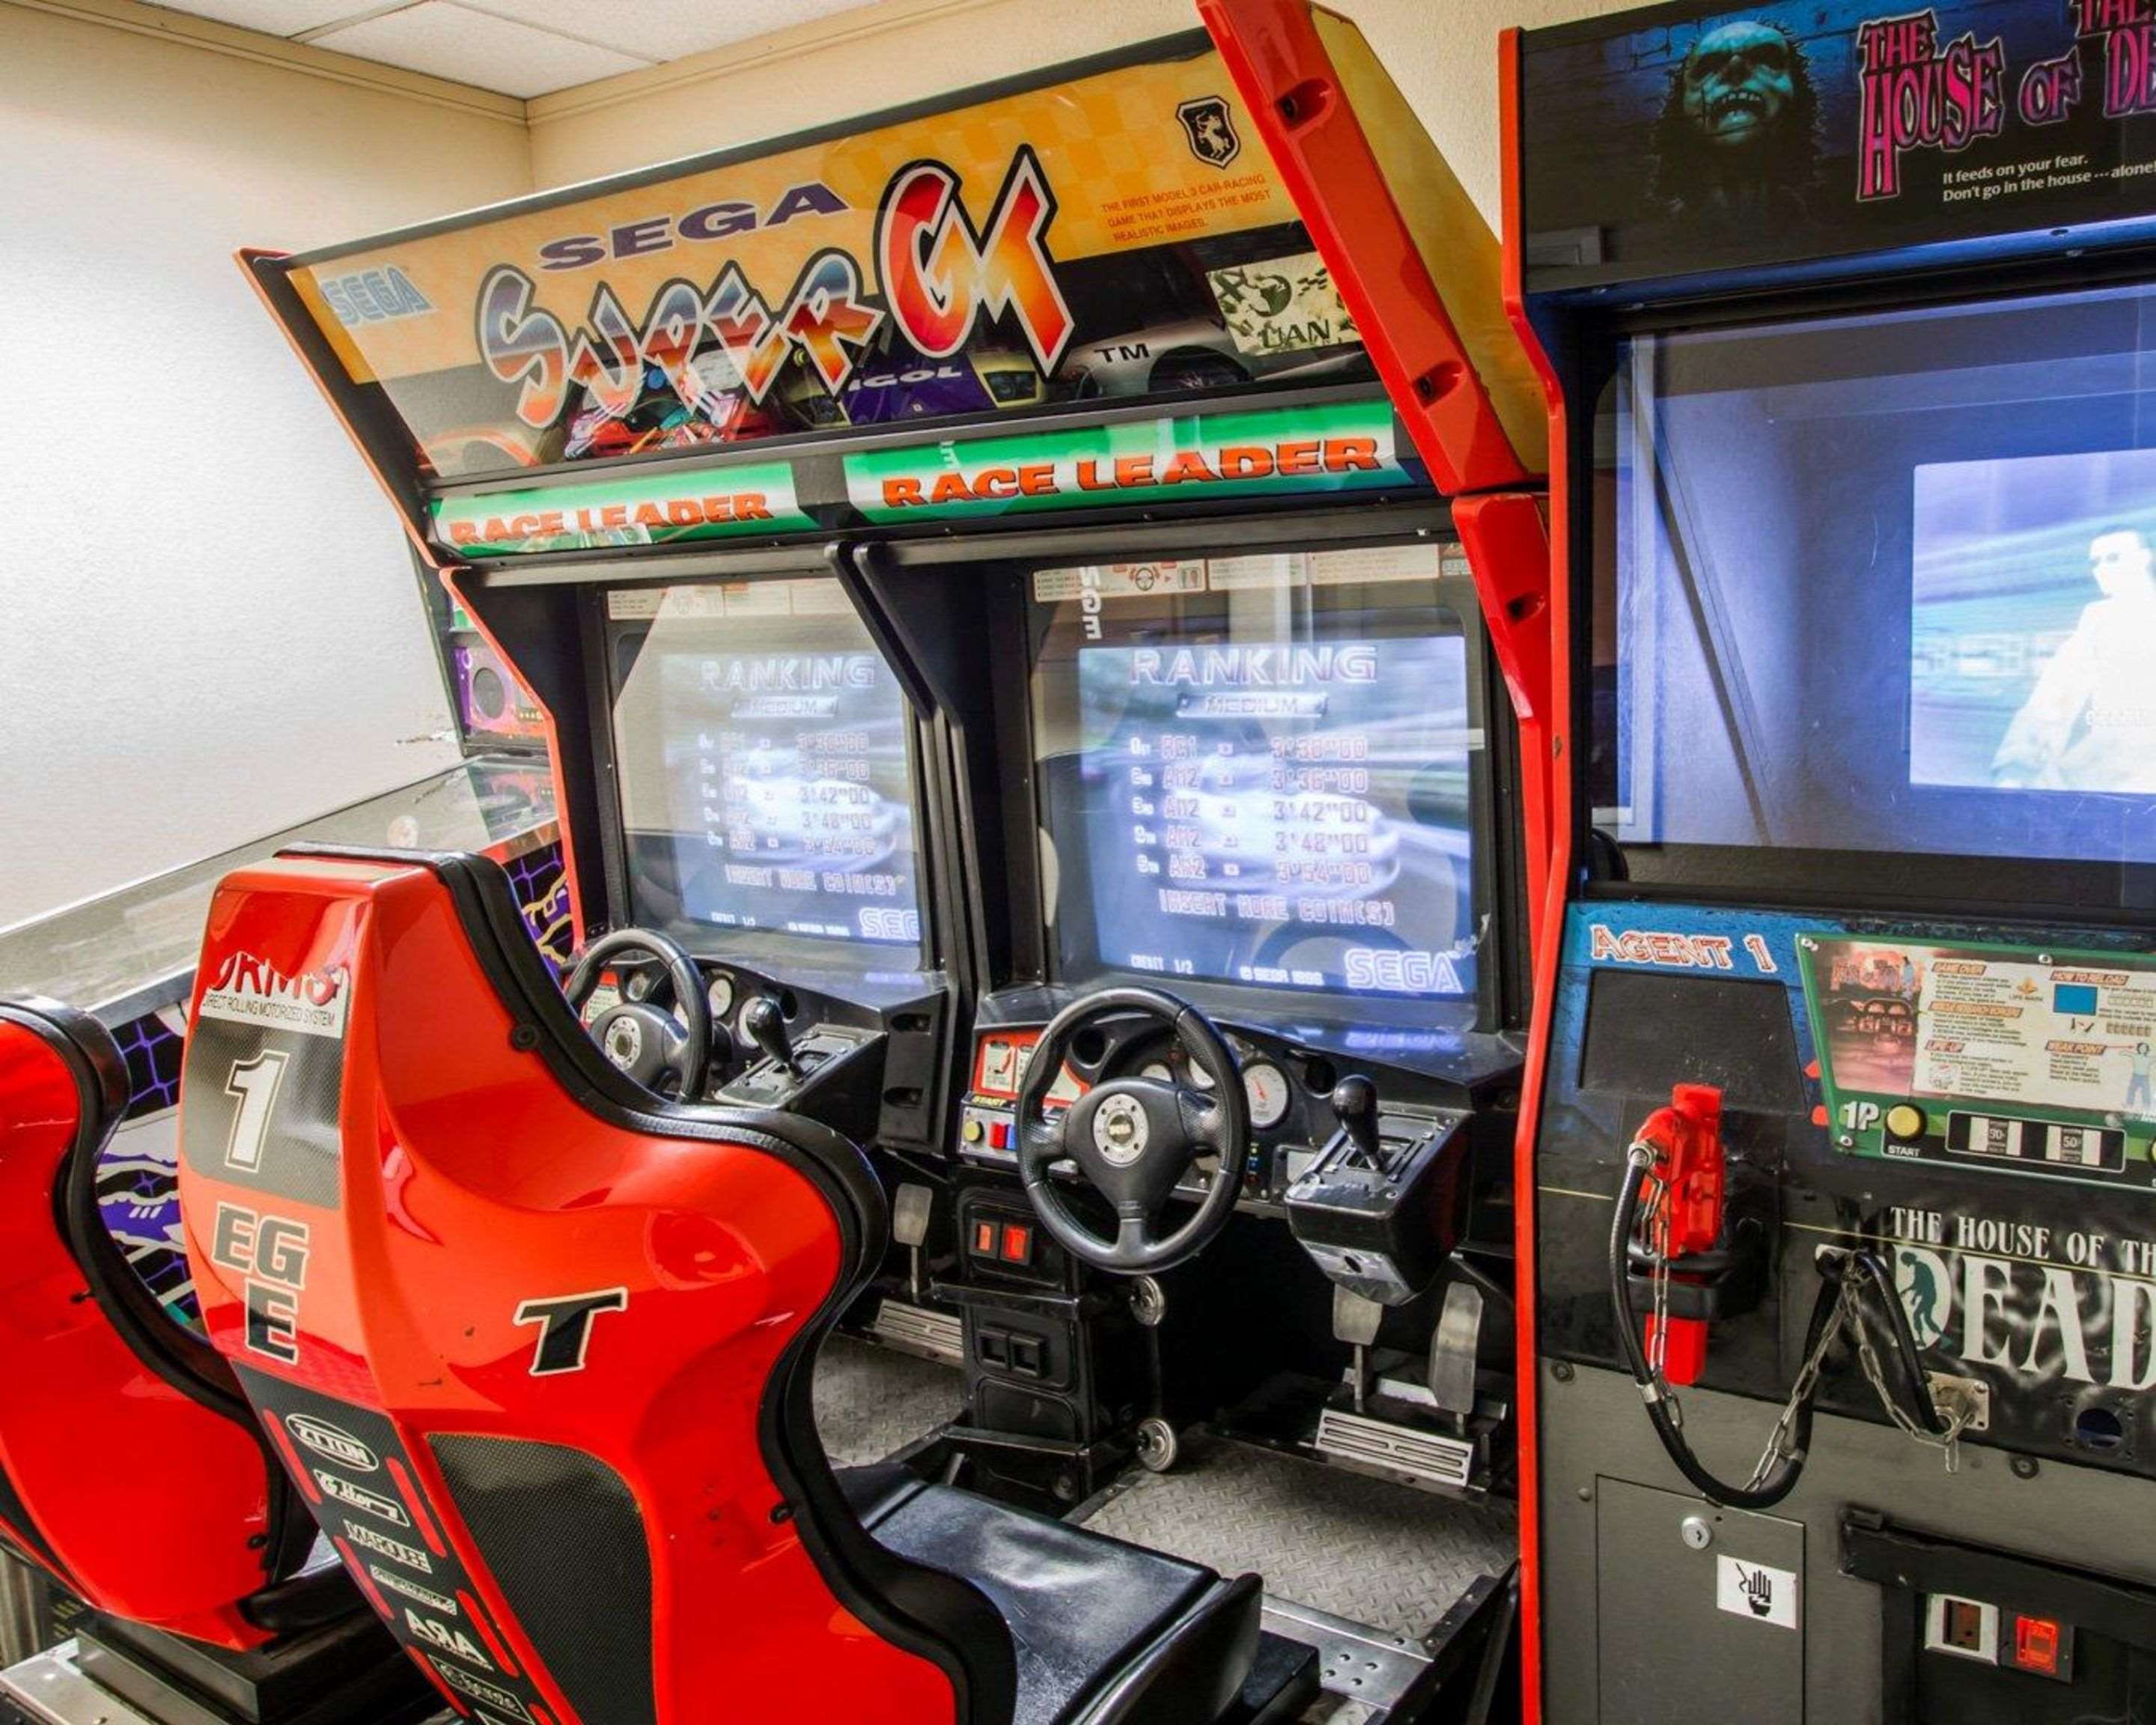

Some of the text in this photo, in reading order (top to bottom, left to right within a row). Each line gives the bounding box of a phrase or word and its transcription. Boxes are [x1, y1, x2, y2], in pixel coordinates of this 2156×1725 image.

[1858, 8, 1937, 70] THE
[1857, 32, 2082, 201] HOUSE OF
[1943, 154, 2089, 184] It feeds on your fear.
[1943, 185, 1980, 202] Don't
[1983, 184, 2001, 200] go
[2004, 181, 2018, 194] in
[2021, 177, 2045, 191] the
[2047, 170, 2092, 187] house
[1101, 202, 1122, 213] THE
[1123, 195, 1150, 210] FIRST
[1152, 189, 1186, 204] MODEL
[1107, 215, 1136, 228] GAME
[1219, 195, 1238, 207] THE
[1240, 189, 1273, 203] MOST
[538, 181, 849, 272] SEGA
[320, 267, 437, 327] SEGA
[1094, 342, 1151, 364] TM
[882, 437, 1382, 508] RACE LEADER
[448, 491, 775, 546] RACE LEADER
[699, 655, 876, 691] RANKING
[1129, 645, 1377, 686] RANKING
[859, 907, 920, 941] SEG
[1590, 923, 1778, 973] AGENT 1
[1345, 949, 1464, 994] SEGA
[225, 1048, 290, 1173] 1
[1842, 1101, 1879, 1130] 1P
[1888, 1144, 1919, 1157] START
[1890, 1206, 2156, 1274] THE HOUSE OF TH
[244, 1277, 298, 1365] E
[513, 1287, 628, 1377] T
[1891, 1243, 2156, 1391] DEAD
